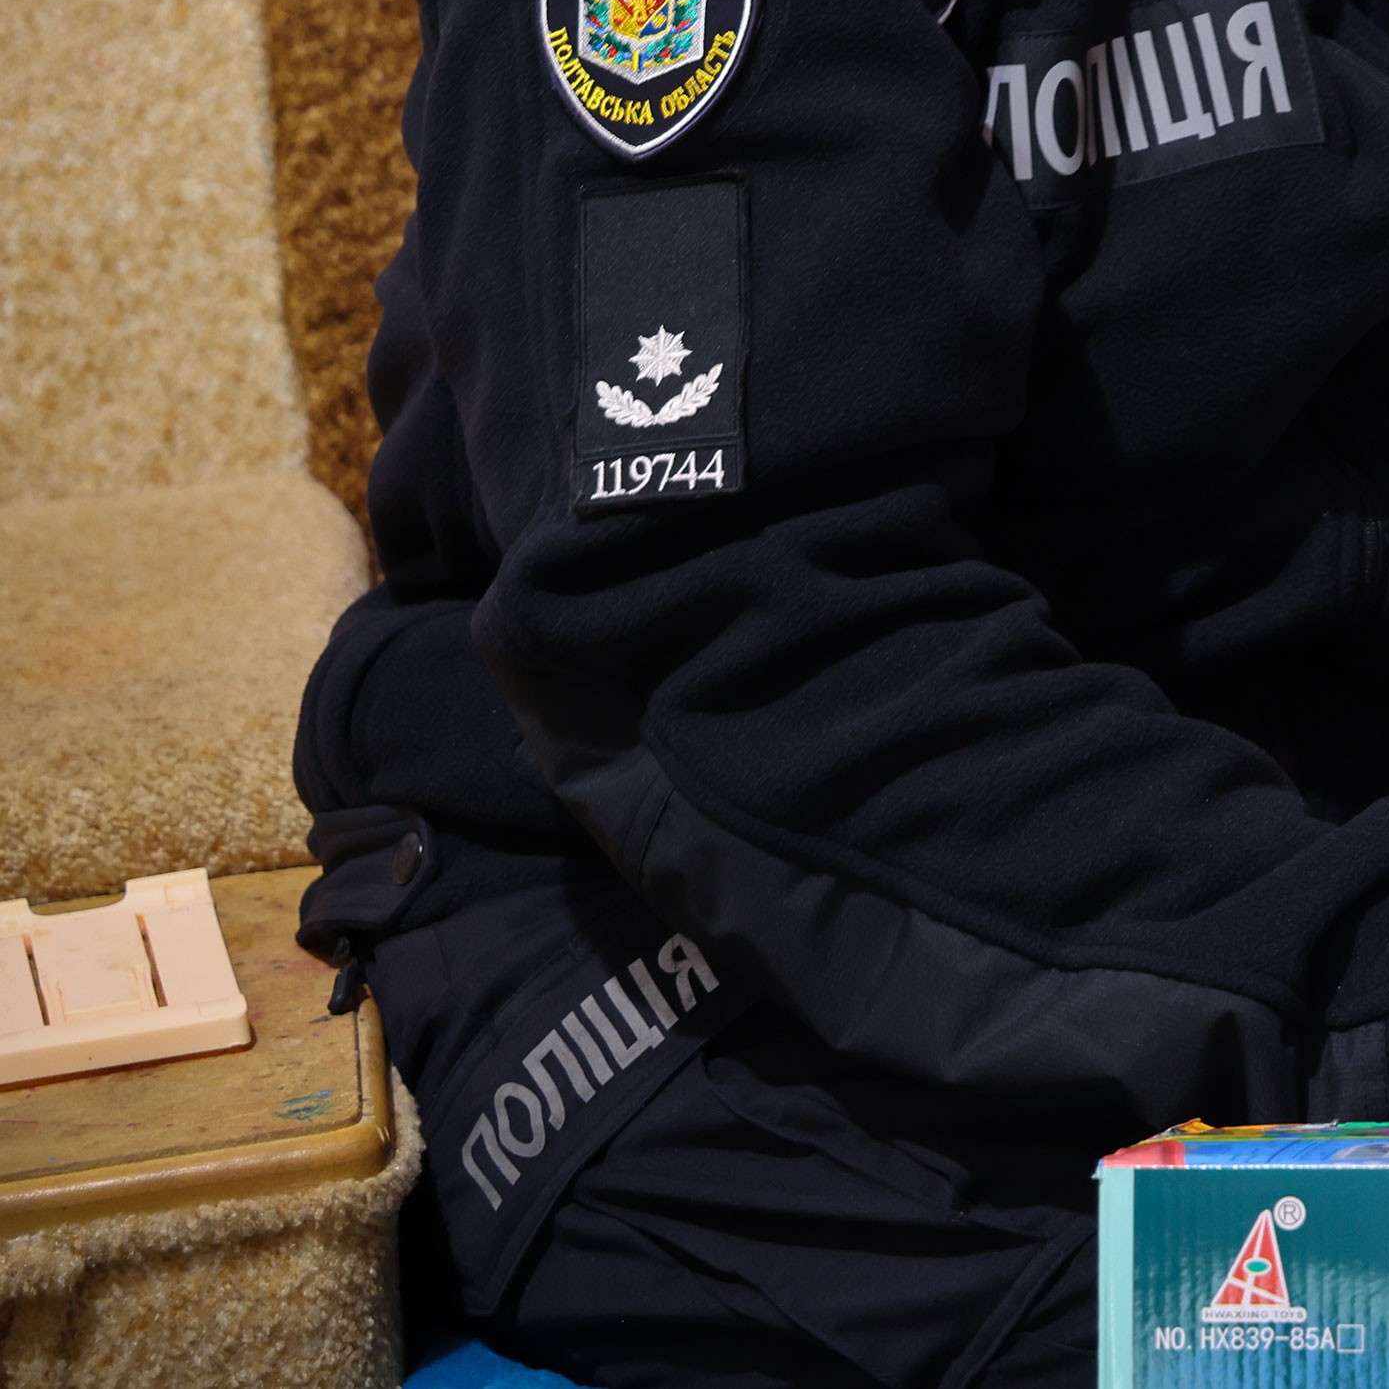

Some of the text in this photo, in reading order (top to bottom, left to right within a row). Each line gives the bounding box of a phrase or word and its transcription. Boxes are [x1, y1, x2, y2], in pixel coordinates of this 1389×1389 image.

[549, 27, 737, 125] ПОЛТАВСЬКА ОБЛАСТЬ
[981, 1, 1292, 180] ПОЛІЦІЯ
[590, 449, 725, 500] 119744
[461, 932, 720, 1211] ПОЛІЦІЯ
[1155, 1326, 1336, 1351] NO. HX839-85A
[1273, 1310, 1304, 1319] TOYS
